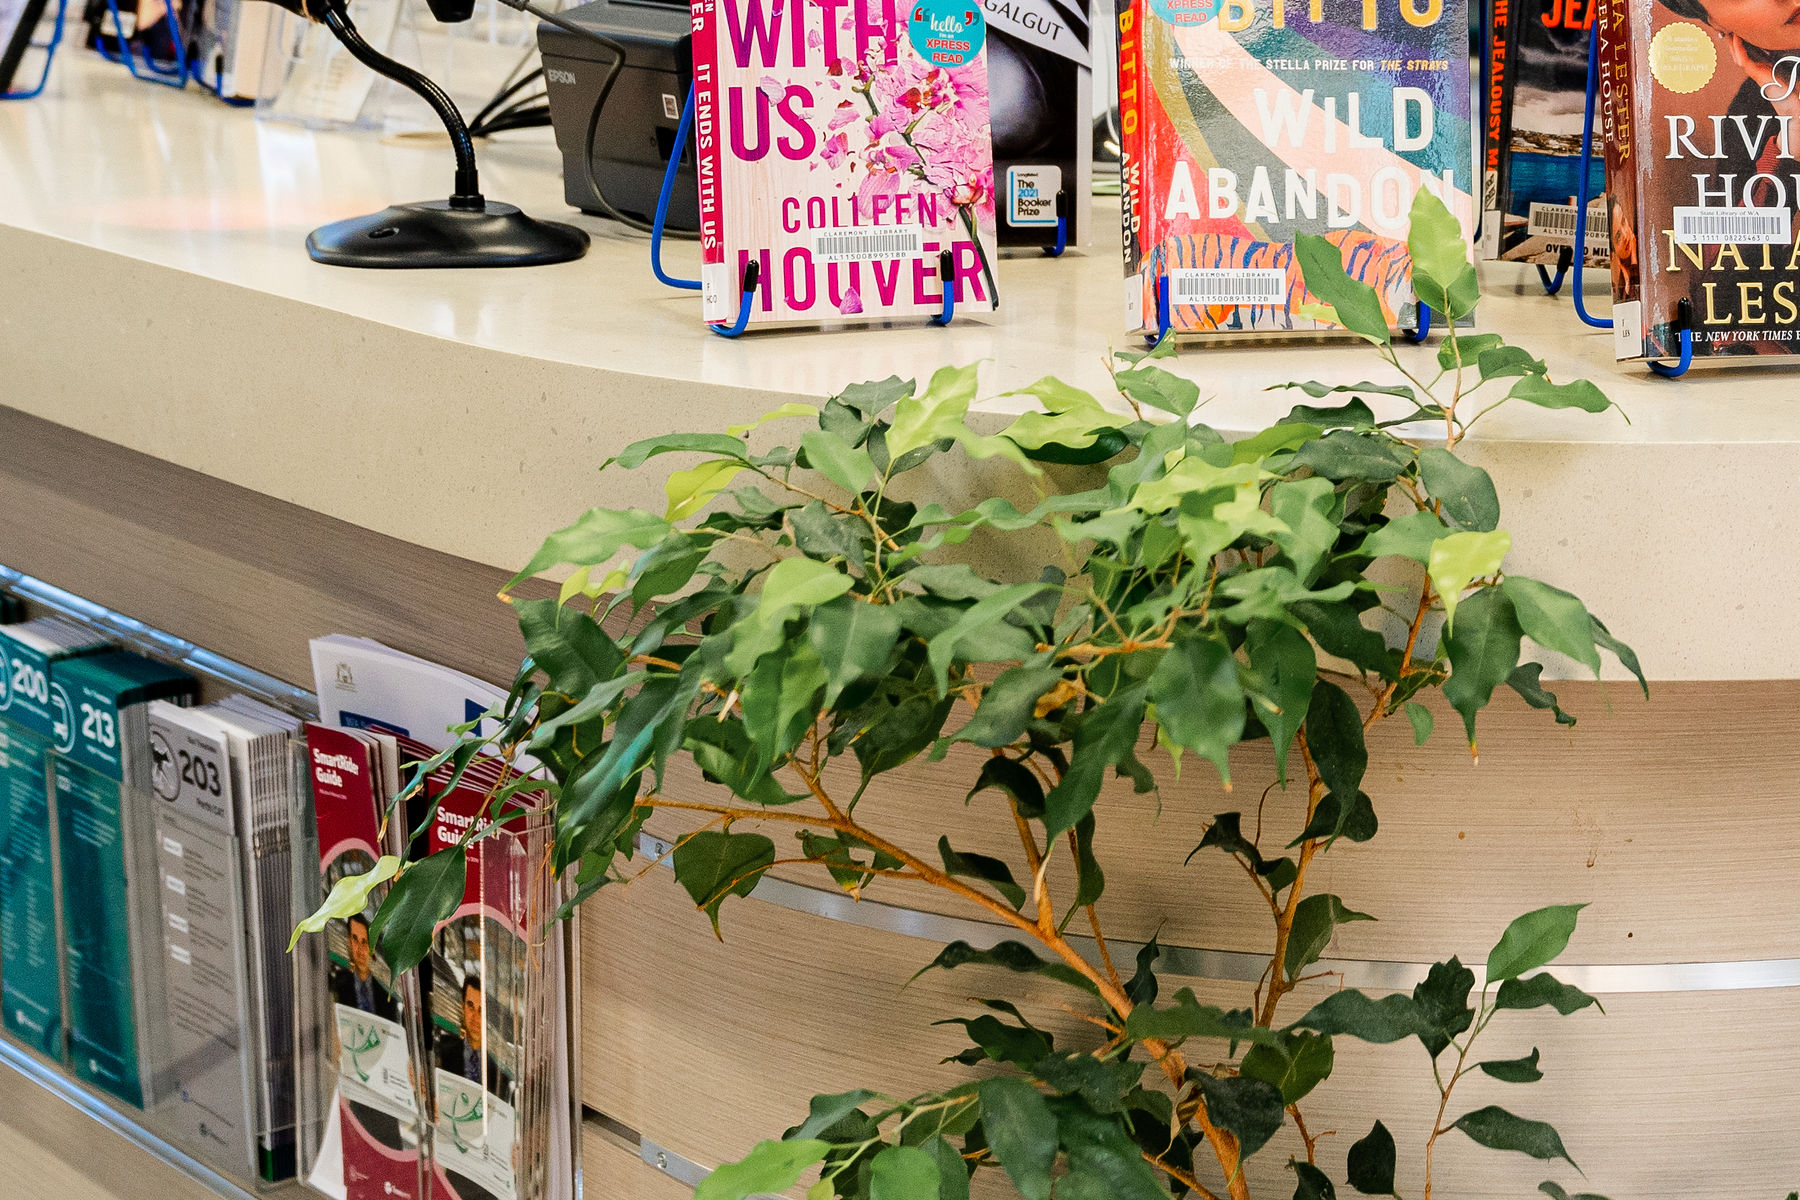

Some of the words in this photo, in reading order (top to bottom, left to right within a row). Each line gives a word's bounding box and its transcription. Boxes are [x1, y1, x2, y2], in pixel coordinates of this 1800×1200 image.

[930, 13, 964, 33] hello
[1175, 11, 1207, 23] READ
[925, 38, 971, 53] XPRESS
[931, 51, 964, 65] READ
[1265, 59, 1310, 71] STELLA
[1314, 59, 1348, 71] PRIZE
[1352, 59, 1375, 71] FOR
[1406, 59, 1449, 71] STRAYS
[548, 69, 576, 84] EPSON
[696, 63, 711, 84] IT
[1119, 8, 1138, 136] BITTO
[1489, 38, 1506, 139] JEALOUSY
[698, 90, 713, 150] ENDS
[728, 83, 815, 161] US
[1253, 87, 1434, 154] WILD
[1601, 60, 1613, 145] HOUSE
[1614, 40, 1630, 164] LESTER
[699, 155, 715, 213] WITH
[1017, 179, 1035, 189] The
[1017, 198, 1051, 208] Booker
[1018, 188, 1039, 198] 2021
[1129, 161, 1141, 234] WILD
[1164, 160, 1454, 229] ABANDON
[781, 192, 938, 234] COLLEEN
[1017, 207, 1040, 217] Prize
[1121, 151, 1131, 264] ABANDON
[702, 221, 716, 250] US
[738, 241, 987, 312] HOOVER
[1705, 330, 1731, 342] NEW
[1731, 330, 1761, 342] YORK
[1762, 330, 1793, 341] TIMES
[11, 658, 49, 704] 200
[80, 703, 116, 749] 213
[178, 750, 222, 797] 203
[312, 747, 359, 776] SmartRider
[315, 767, 343, 788] Guide
